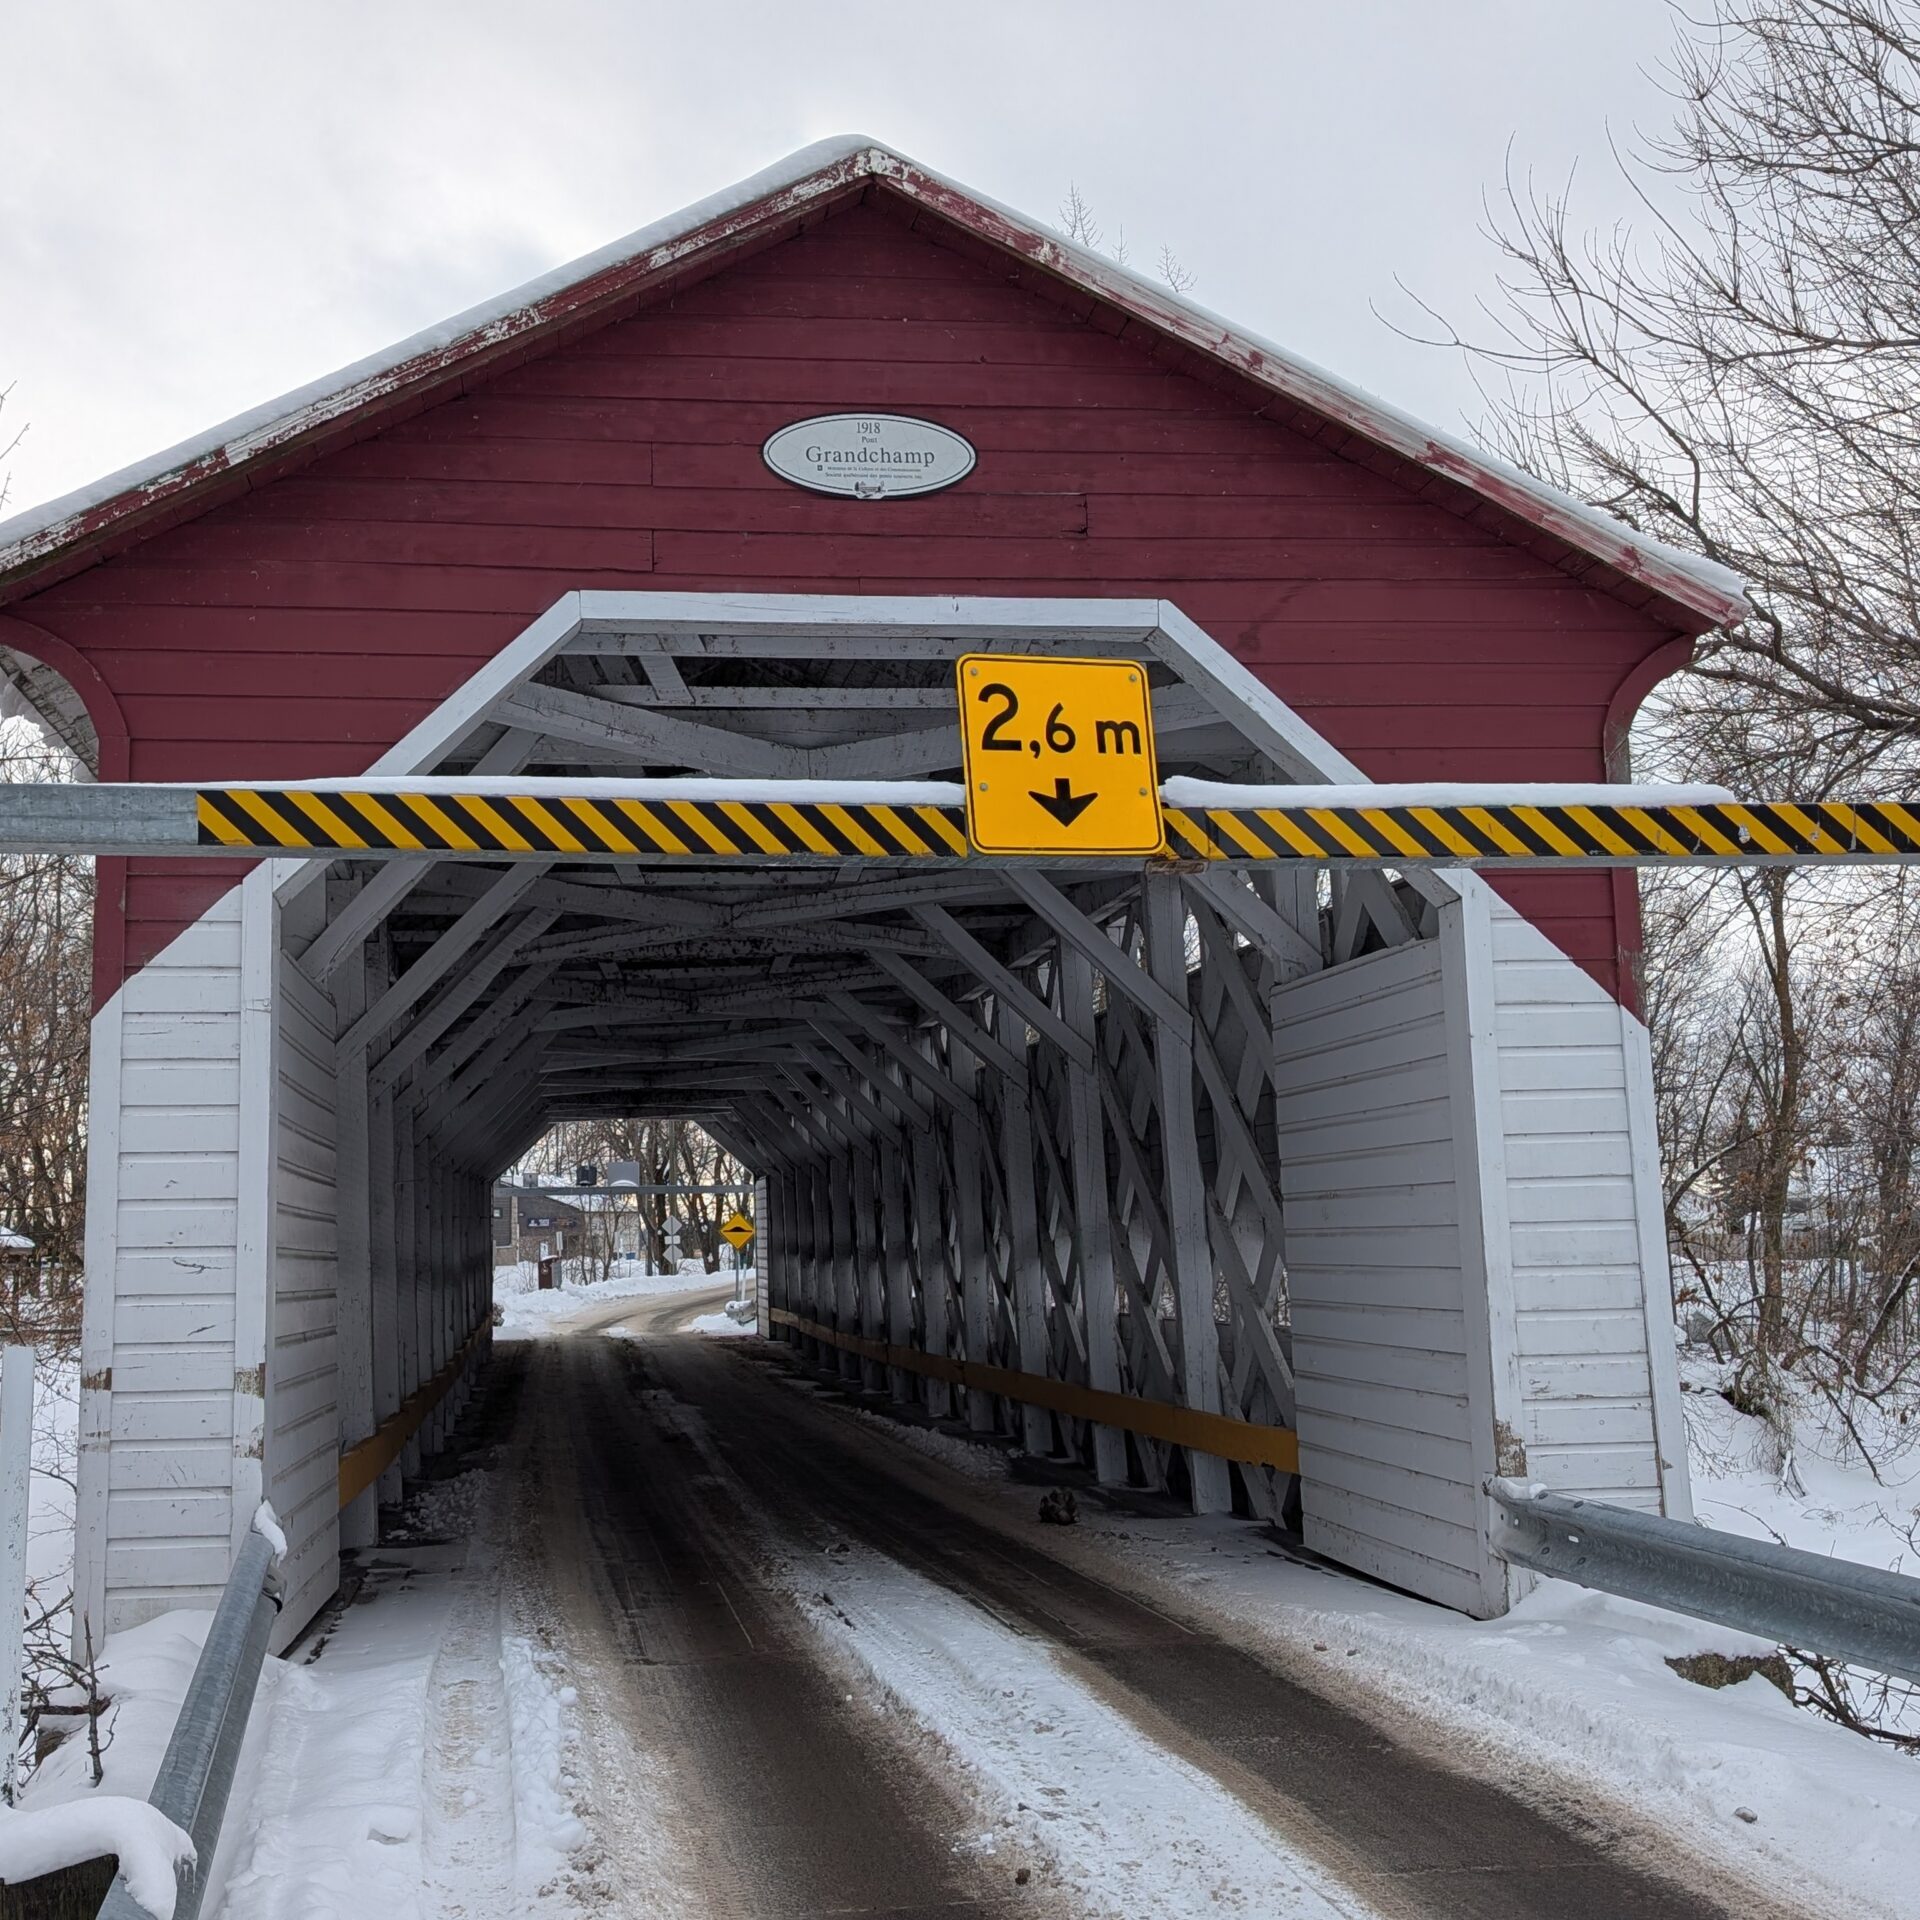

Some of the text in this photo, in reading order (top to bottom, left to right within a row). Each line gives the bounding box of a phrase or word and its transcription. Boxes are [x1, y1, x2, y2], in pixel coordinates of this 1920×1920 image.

[856, 422, 881, 434] 1918
[805, 445, 935, 467] Grandchamp
[977, 682, 1142, 760] 2,6 m
